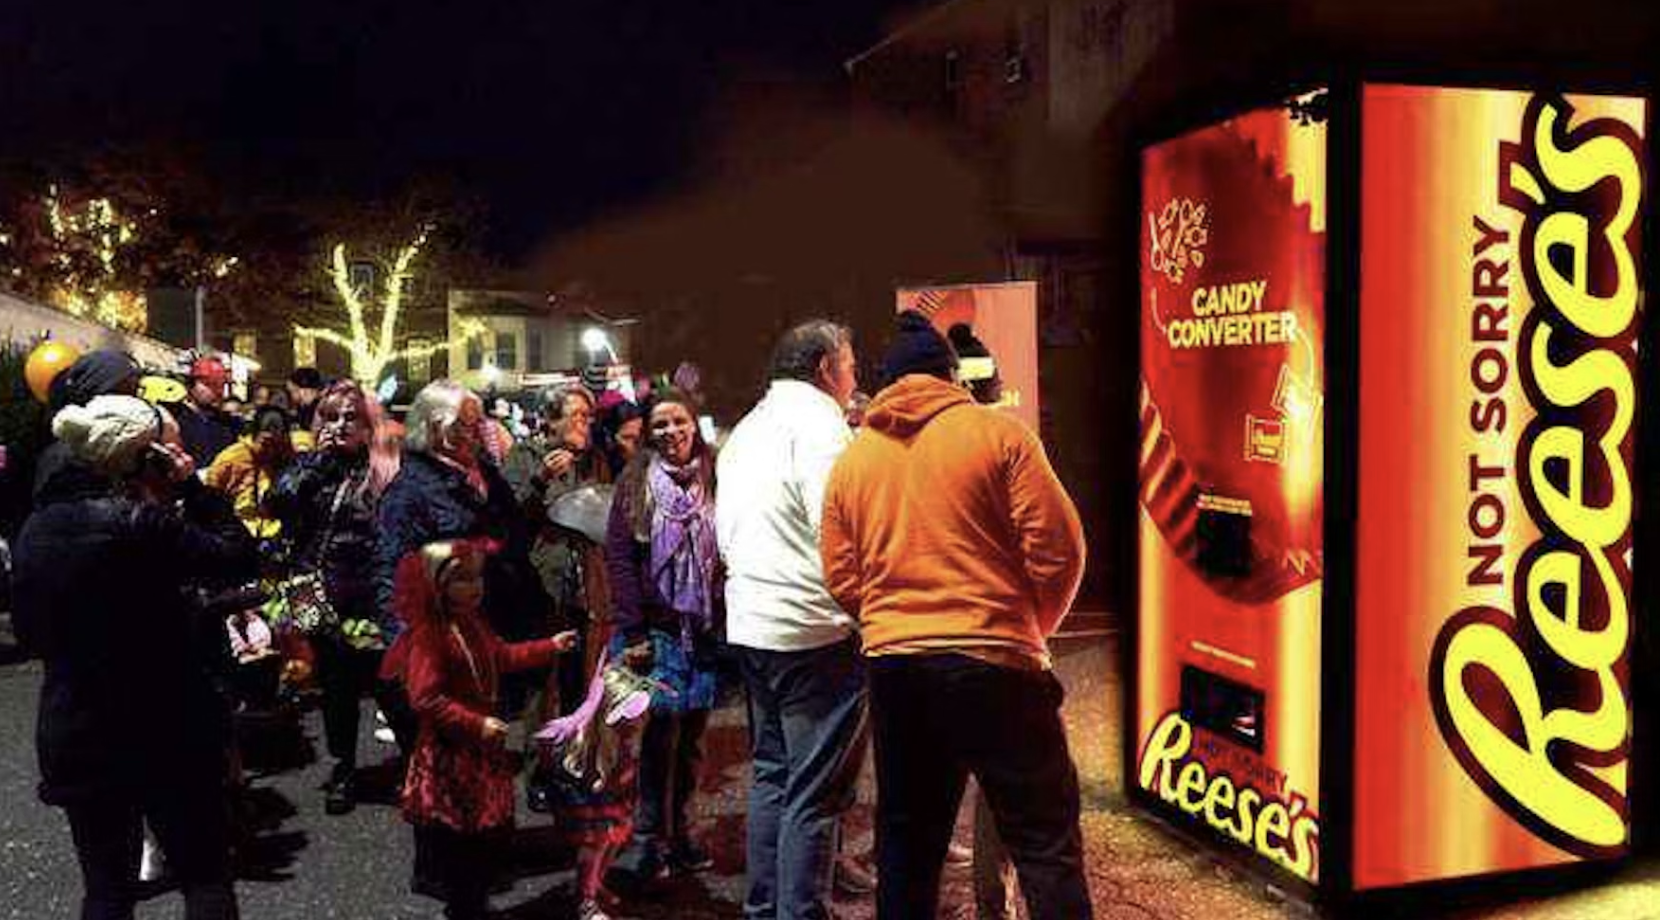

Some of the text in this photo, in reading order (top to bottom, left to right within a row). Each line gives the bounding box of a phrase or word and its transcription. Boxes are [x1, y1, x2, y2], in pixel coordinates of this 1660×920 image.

[1168, 310, 1298, 348] CONVERTER
[1192, 280, 1266, 316] CANDY
[1440, 100, 1644, 848] Reese's
[1467, 215, 1510, 586] NOT SORRY
[1139, 711, 1319, 880] Reese's
